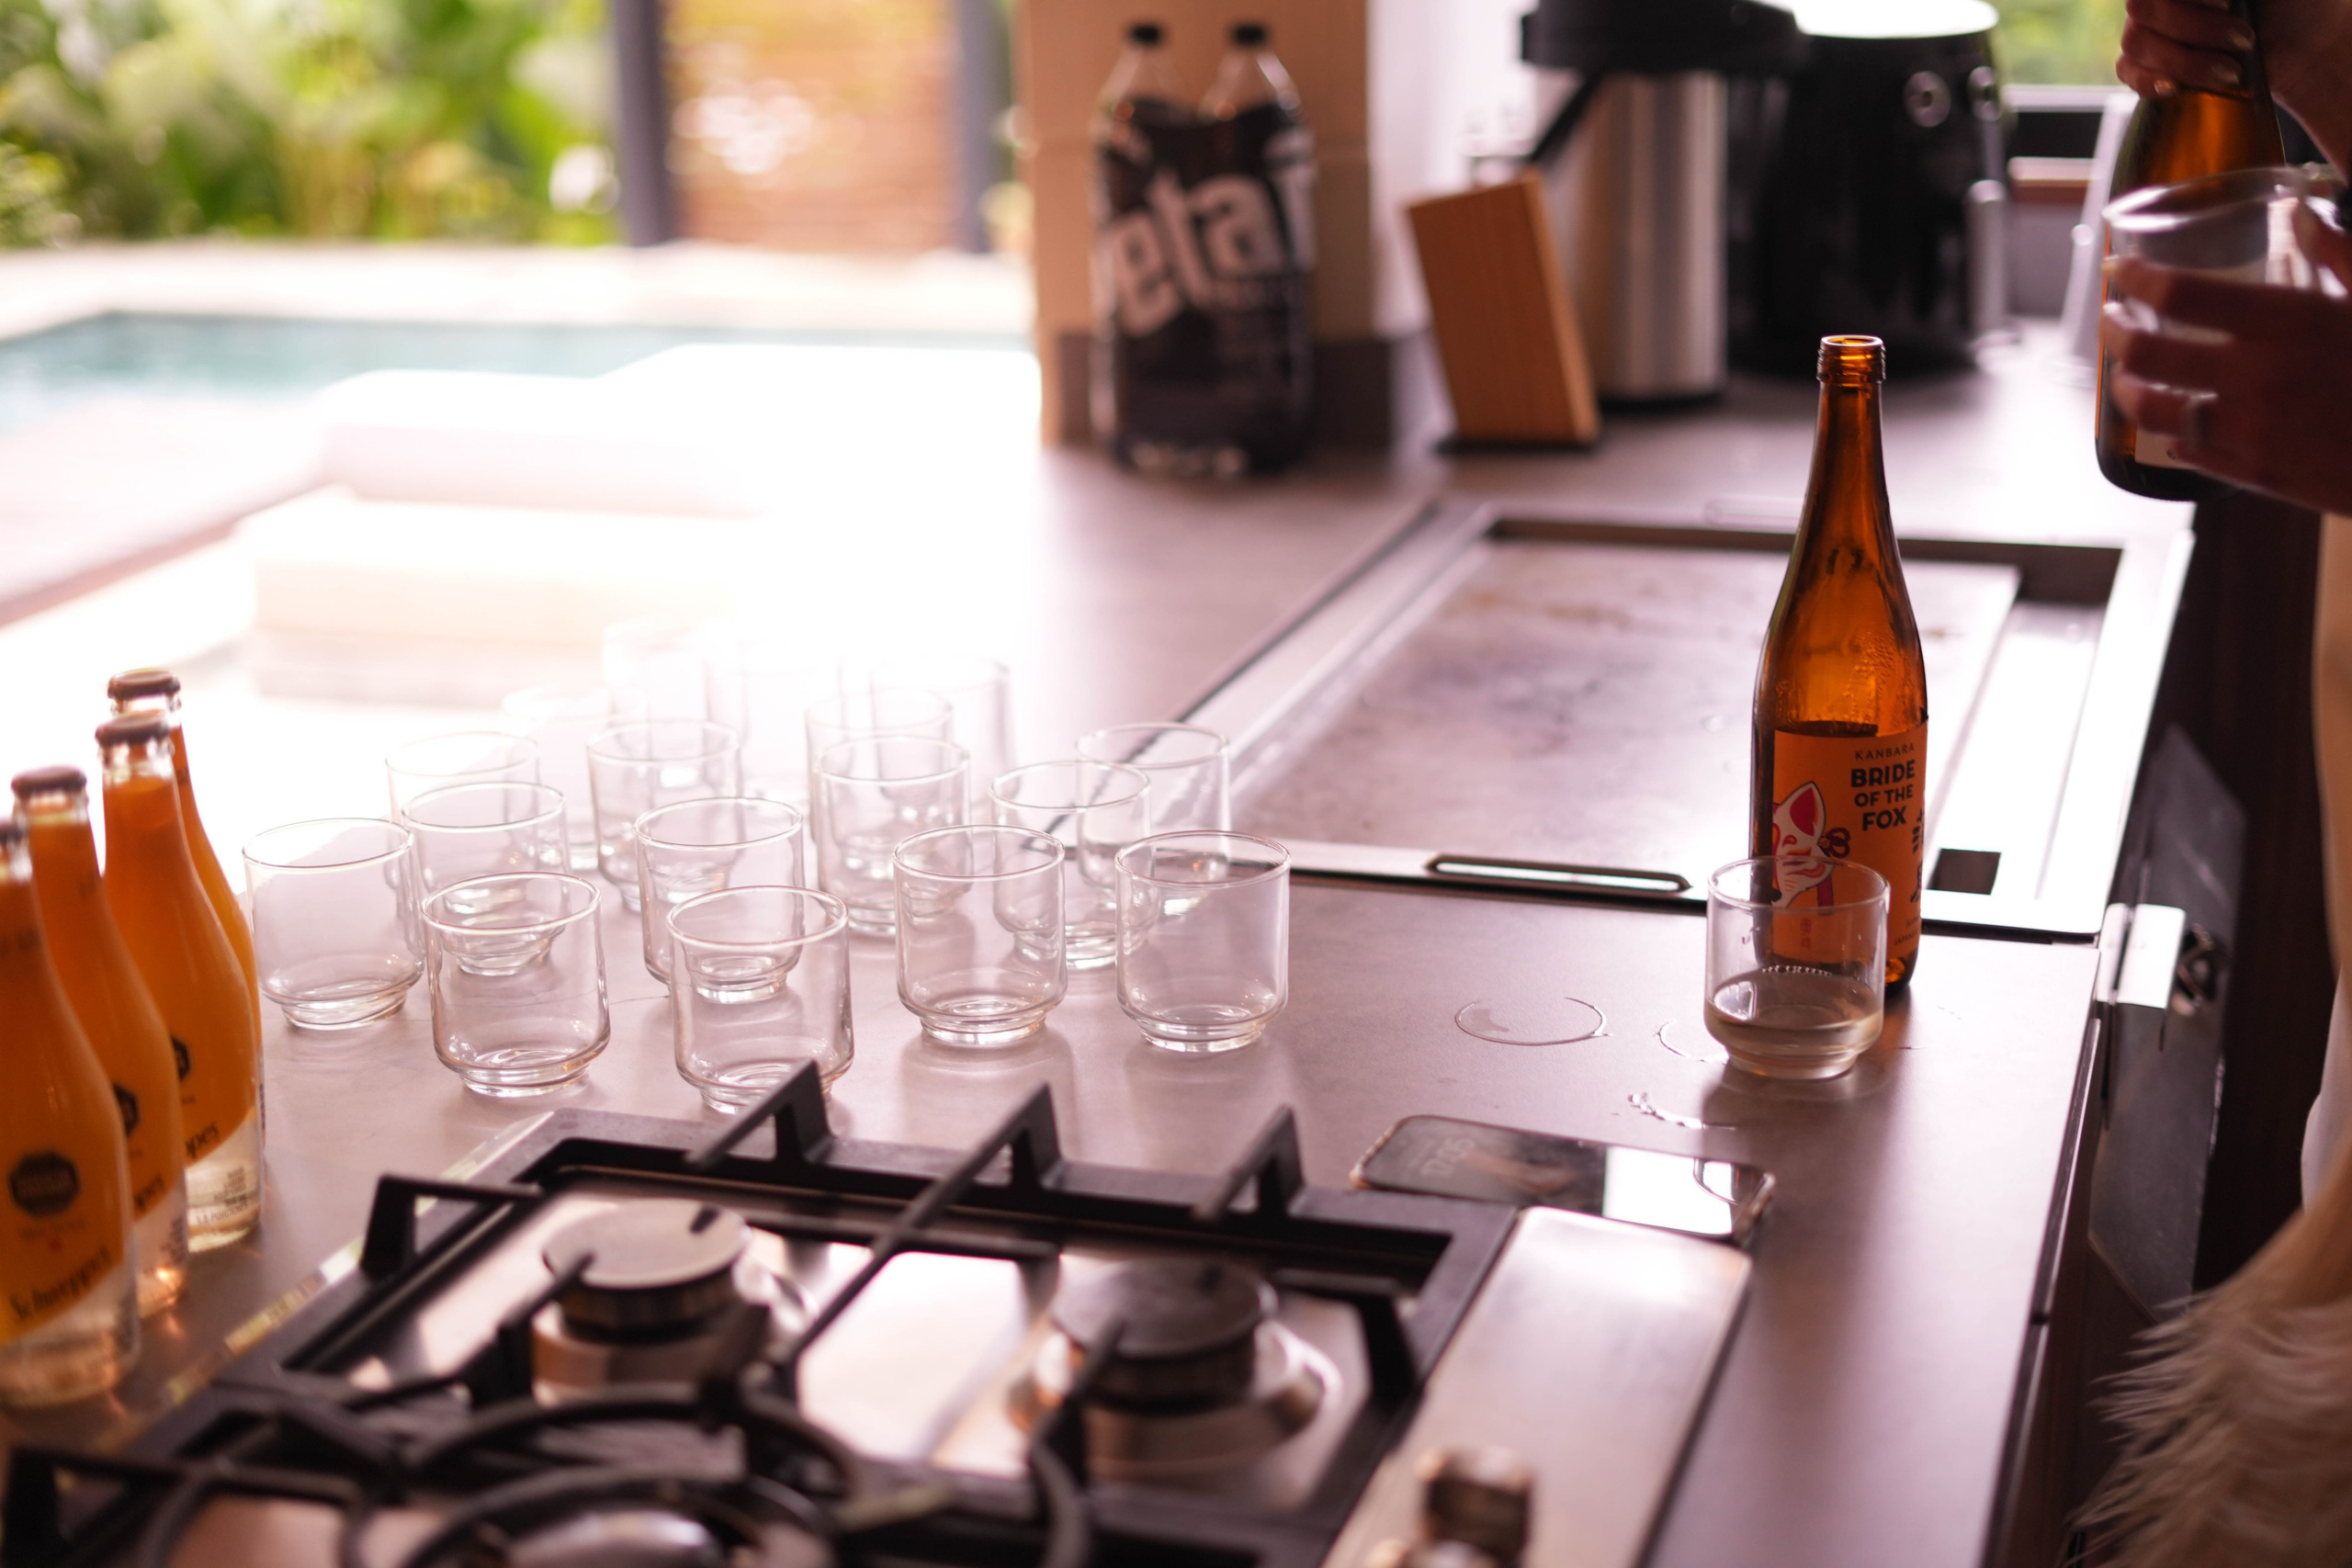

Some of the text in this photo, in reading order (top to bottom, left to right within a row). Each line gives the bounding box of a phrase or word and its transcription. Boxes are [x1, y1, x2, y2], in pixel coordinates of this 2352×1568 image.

[1855, 742, 1915, 761] KANBARA
[1850, 759, 1916, 787] BRIDE
[1854, 784, 1914, 807] OF THE
[1861, 806, 1906, 831] FOX
